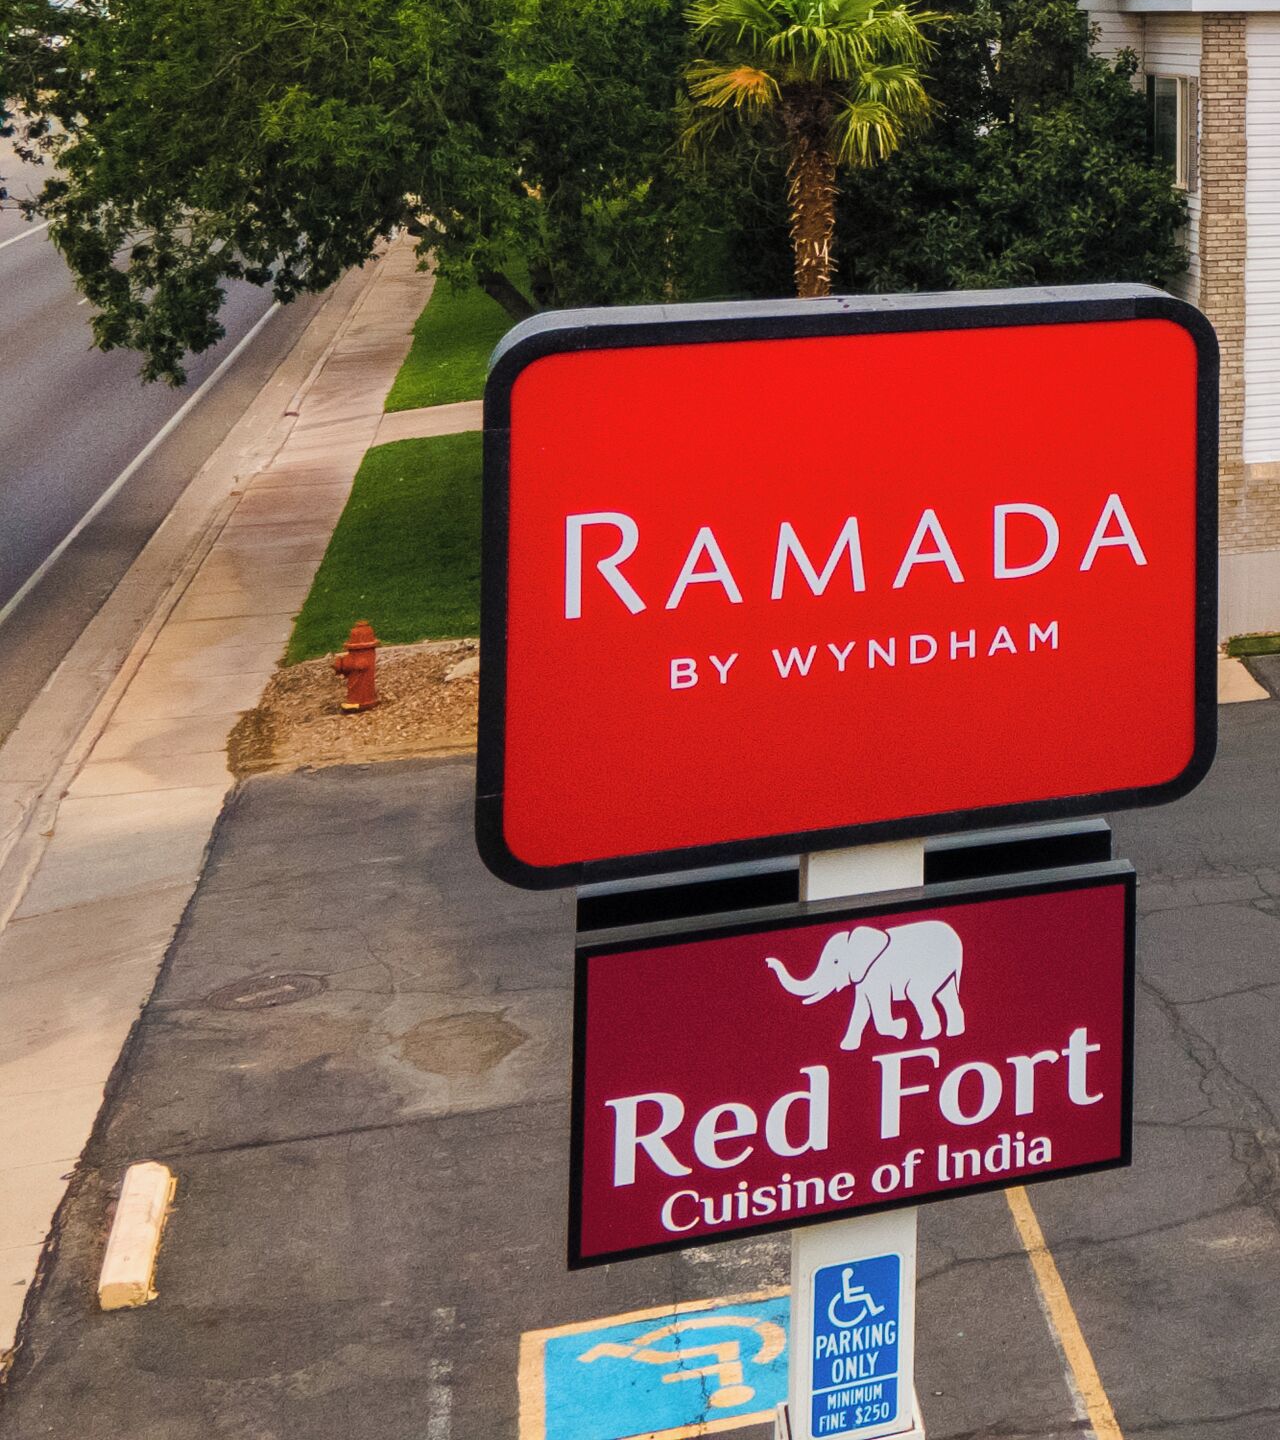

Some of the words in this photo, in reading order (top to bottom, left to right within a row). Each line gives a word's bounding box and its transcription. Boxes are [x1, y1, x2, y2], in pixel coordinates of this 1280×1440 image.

[566, 493, 1147, 620] RAMADA
[670, 653, 738, 690] BY
[772, 620, 1059, 678] WYNDHAM
[604, 1064, 830, 1187] Red
[872, 1027, 1104, 1139] Fort
[660, 1169, 855, 1232] Cuisine
[871, 1148, 925, 1192] of
[937, 1131, 1052, 1181] India
[815, 1320, 896, 1359] PARKING
[831, 1351, 879, 1384] ONLY
[818, 1411, 847, 1432] FINE
[855, 1402, 890, 1425] $250
[827, 1383, 883, 1410] MINIMUM
